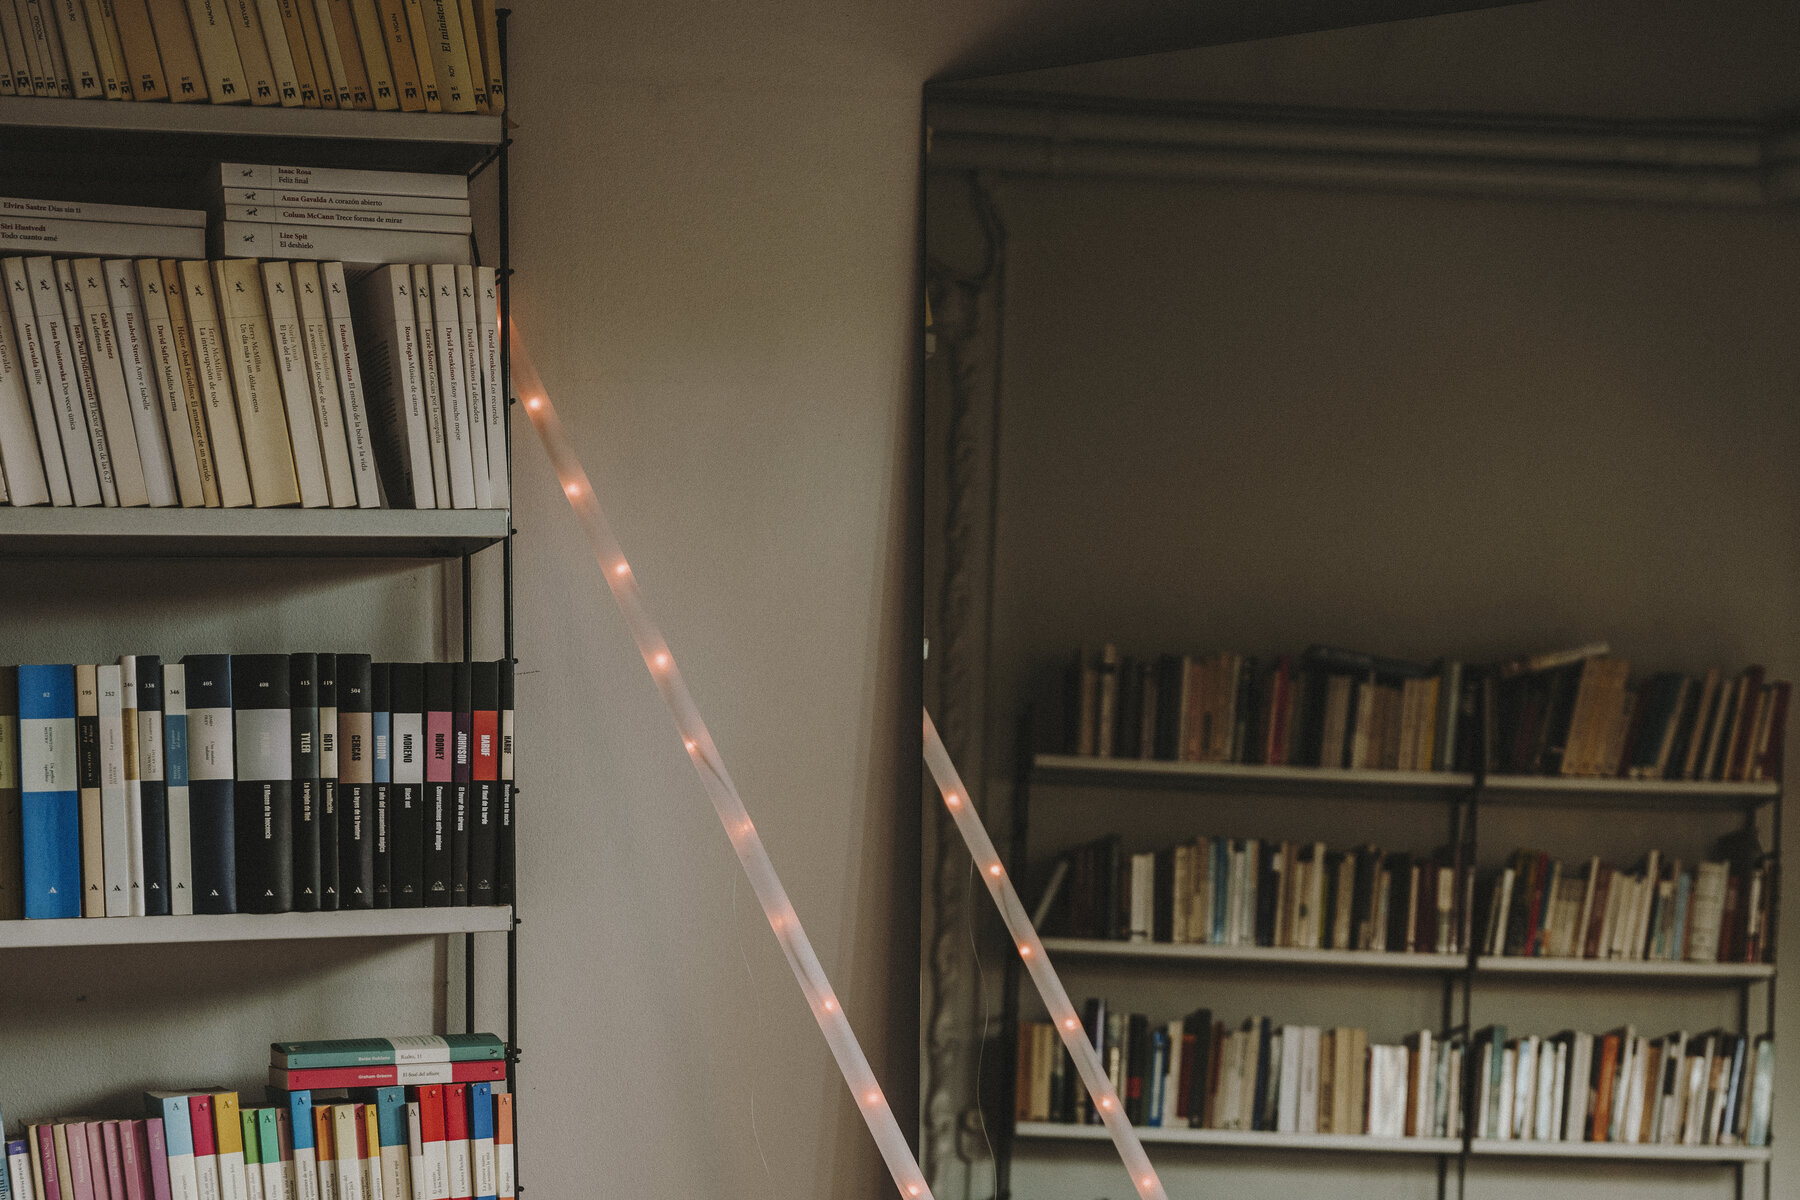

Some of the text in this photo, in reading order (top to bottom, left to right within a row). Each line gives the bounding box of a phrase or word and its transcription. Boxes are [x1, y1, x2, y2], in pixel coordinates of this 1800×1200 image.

[433, 0, 451, 52] El minister
[4, 202, 24, 210] Elvira
[25, 203, 46, 211] Sastre
[15, 224, 46, 232] Hustvedt
[294, 233, 308, 241] Spit
[24, 322, 34, 340] Anna
[49, 320, 59, 339] Elena
[90, 312, 104, 352] Las defensas
[126, 312, 137, 342] Elizabeth
[156, 324, 166, 344] David
[246, 323, 257, 340] Terry
[308, 324, 315, 332] La
[339, 323, 349, 351] Eduardo
[466, 328, 474, 347] David
[73, 323, 86, 355] Jean-Paul
[424, 328, 432, 348] Lorrie
[28, 340, 39, 368] Gavalda
[53, 340, 67, 381] Poniatowska
[131, 343, 141, 364] Strout
[181, 348, 191, 366] Abad
[284, 356, 293, 372] alma
[426, 349, 435, 370] Moore
[134, 364, 144, 381] Amy
[199, 326, 219, 407] La interrupción de todo
[239, 323, 247, 333] Un
[246, 364, 252, 373] un
[251, 392, 259, 413] menos
[313, 360, 321, 370] del
[343, 351, 354, 381] Mendoza
[408, 361, 416, 384] Música
[468, 348, 477, 381] Foenkinos
[488, 349, 497, 382] Foenkinos
[79, 355, 95, 400] Didierlaurent
[164, 364, 174, 390] Maldito
[315, 371, 325, 395] tocador
[445, 326, 462, 440] David Foenkinos Estoy mucho mejor
[61, 382, 70, 395] Dos
[139, 386, 150, 411] Isabelle
[410, 384, 417, 393] de
[168, 390, 178, 411] karma
[319, 395, 327, 404] de
[349, 389, 359, 411] enredo
[491, 394, 499, 424] recuerdos
[90, 408, 100, 426] lector
[192, 408, 202, 438] amanecer
[320, 404, 330, 427] señoras
[352, 412, 360, 420] de
[94, 426, 102, 437] del
[355, 427, 364, 444] bolsa
[96, 437, 105, 451] tren
[197, 438, 205, 447] de
[199, 448, 205, 457] un
[99, 451, 107, 460] de
[101, 460, 109, 470] las
[360, 456, 368, 471] vida
[201, 458, 211, 481] marido
[301, 732, 311, 753] TYLER
[324, 734, 333, 752] ROTH
[352, 735, 361, 761] CERCAS
[376, 735, 386, 760] DIDION
[403, 734, 412, 763] MORENO
[435, 733, 444, 760] ROONEY
[457, 731, 467, 764] JOHNSON
[480, 734, 490, 756] HARUF
